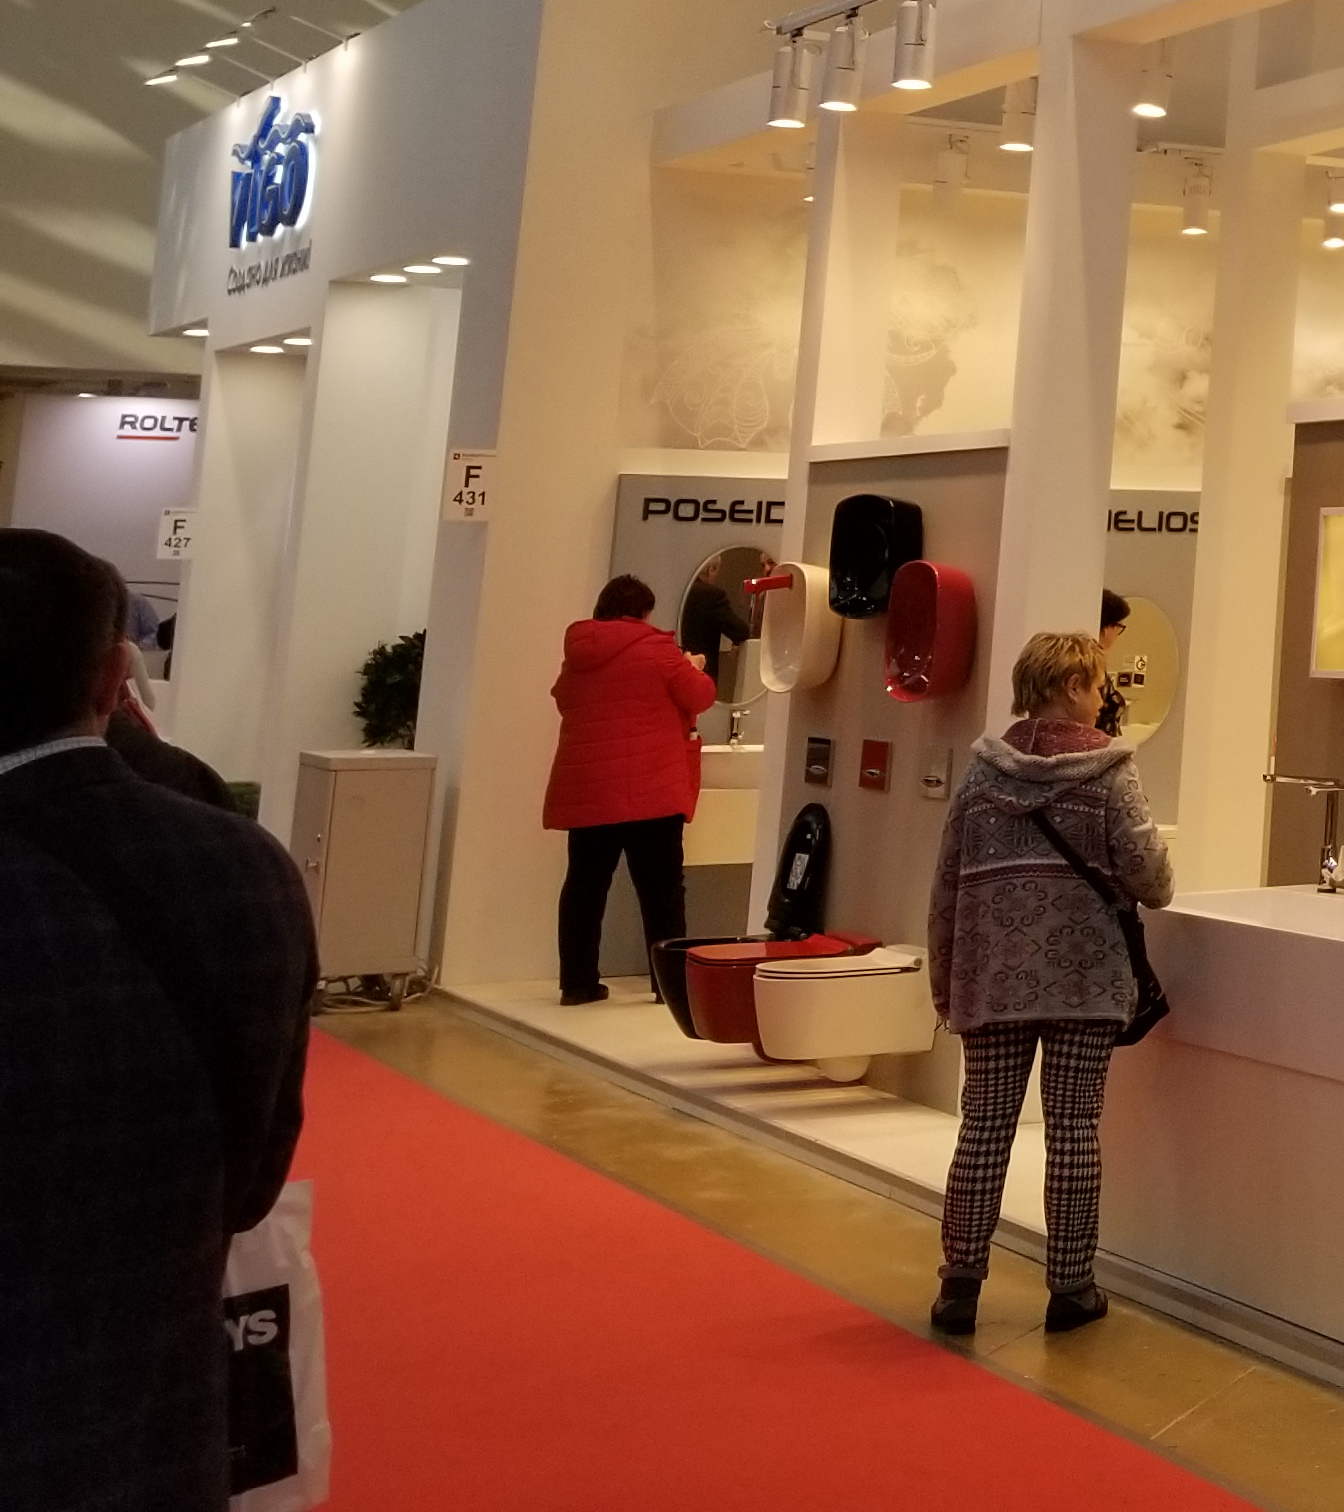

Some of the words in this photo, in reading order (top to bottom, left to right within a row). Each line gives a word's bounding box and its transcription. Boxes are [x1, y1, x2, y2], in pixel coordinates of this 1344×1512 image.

[464, 465, 482, 488] F
[452, 490, 486, 506] 431
[172, 519, 187, 536] F
[164, 537, 191, 548] 427
